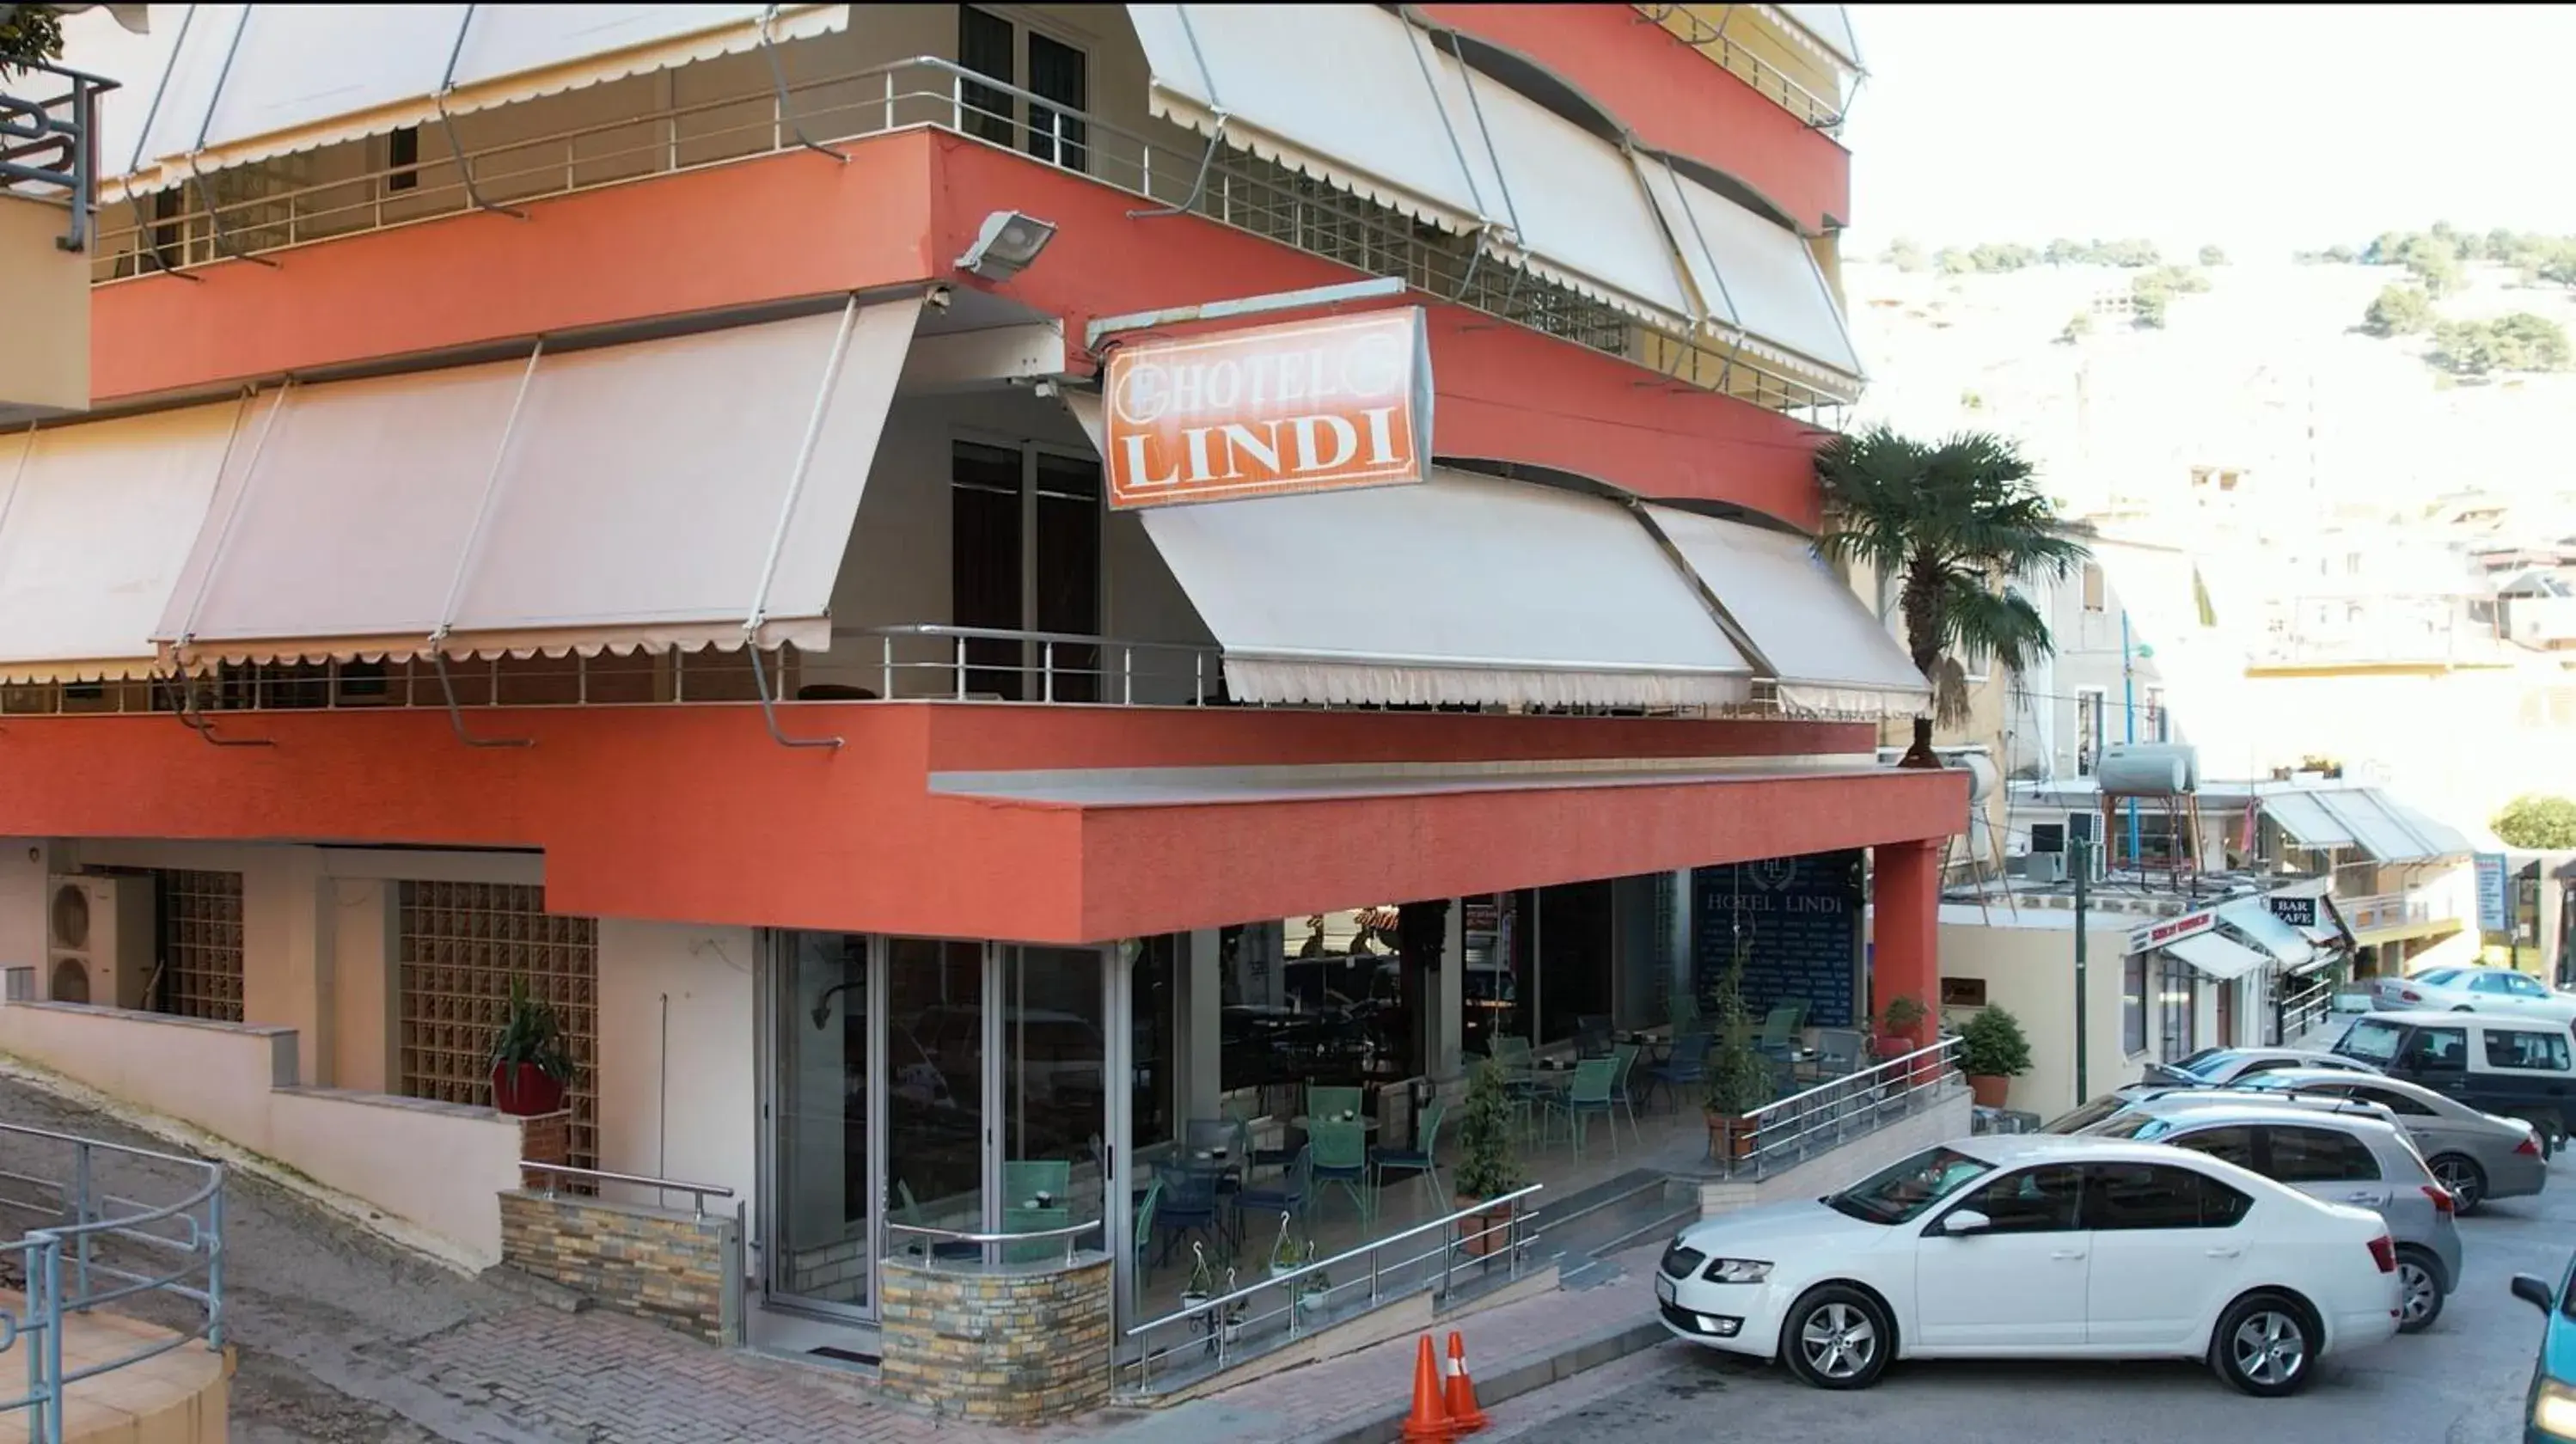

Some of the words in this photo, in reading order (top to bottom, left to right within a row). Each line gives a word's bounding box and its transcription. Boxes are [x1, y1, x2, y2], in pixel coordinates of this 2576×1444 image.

[1172, 348, 1337, 413] HOTEL
[1121, 407, 1404, 489] LINDI
[1707, 893, 1777, 911] HOTEL
[2278, 901, 2308, 911] BAR
